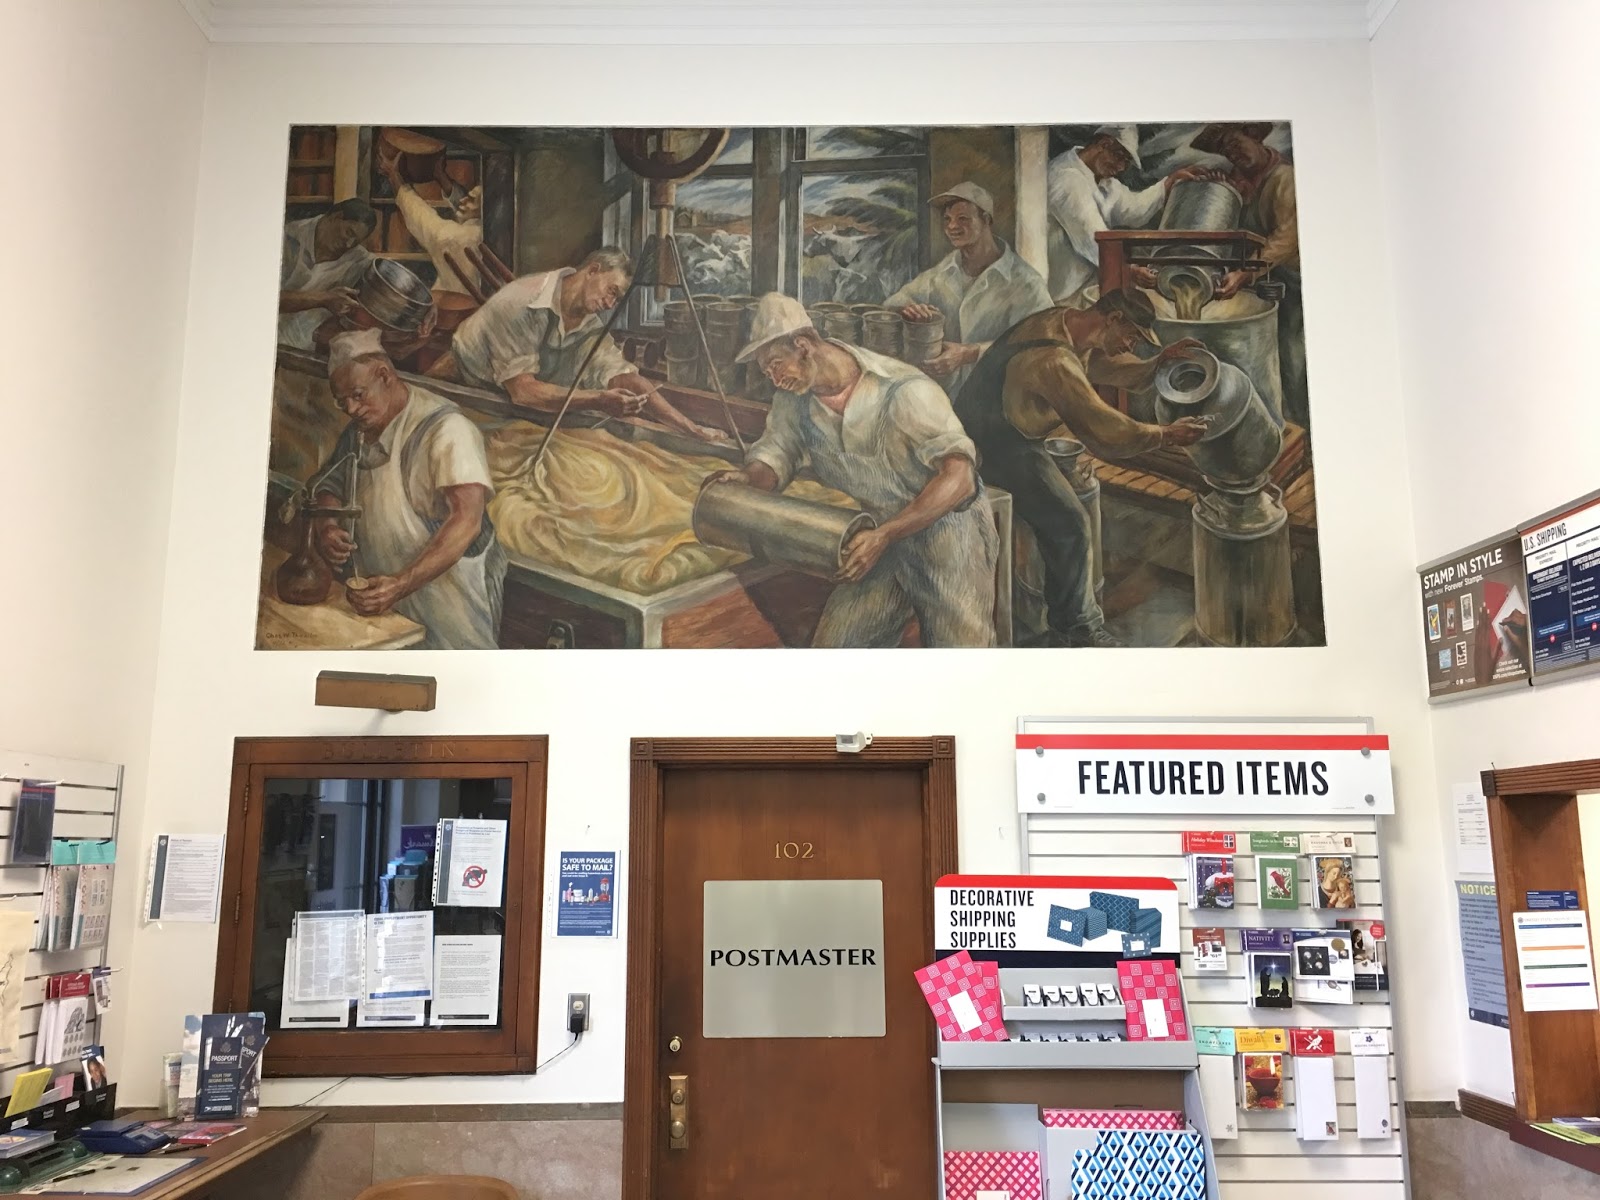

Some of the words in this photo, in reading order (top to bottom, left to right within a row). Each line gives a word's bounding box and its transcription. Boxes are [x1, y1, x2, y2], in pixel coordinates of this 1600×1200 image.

[1523, 537, 1536, 552] U.S.
[1536, 523, 1567, 546] SHIPPING
[1424, 566, 1455, 590] STAMP
[1456, 561, 1468, 578] IN
[1469, 548, 1503, 574] STYLE
[1434, 587, 1443, 596] new
[1444, 581, 1463, 593] Forever
[1078, 760, 1225, 796] FEATURED
[1236, 760, 1330, 797] ITEMS
[774, 842, 815, 859] 102
[950, 889, 1035, 907] DECORATIVE
[1460, 884, 1496, 896] NOTICE
[950, 910, 1016, 928] SHIPPING
[950, 931, 1017, 949] SUPPLIES
[710, 949, 877, 967] POSTMASTER
